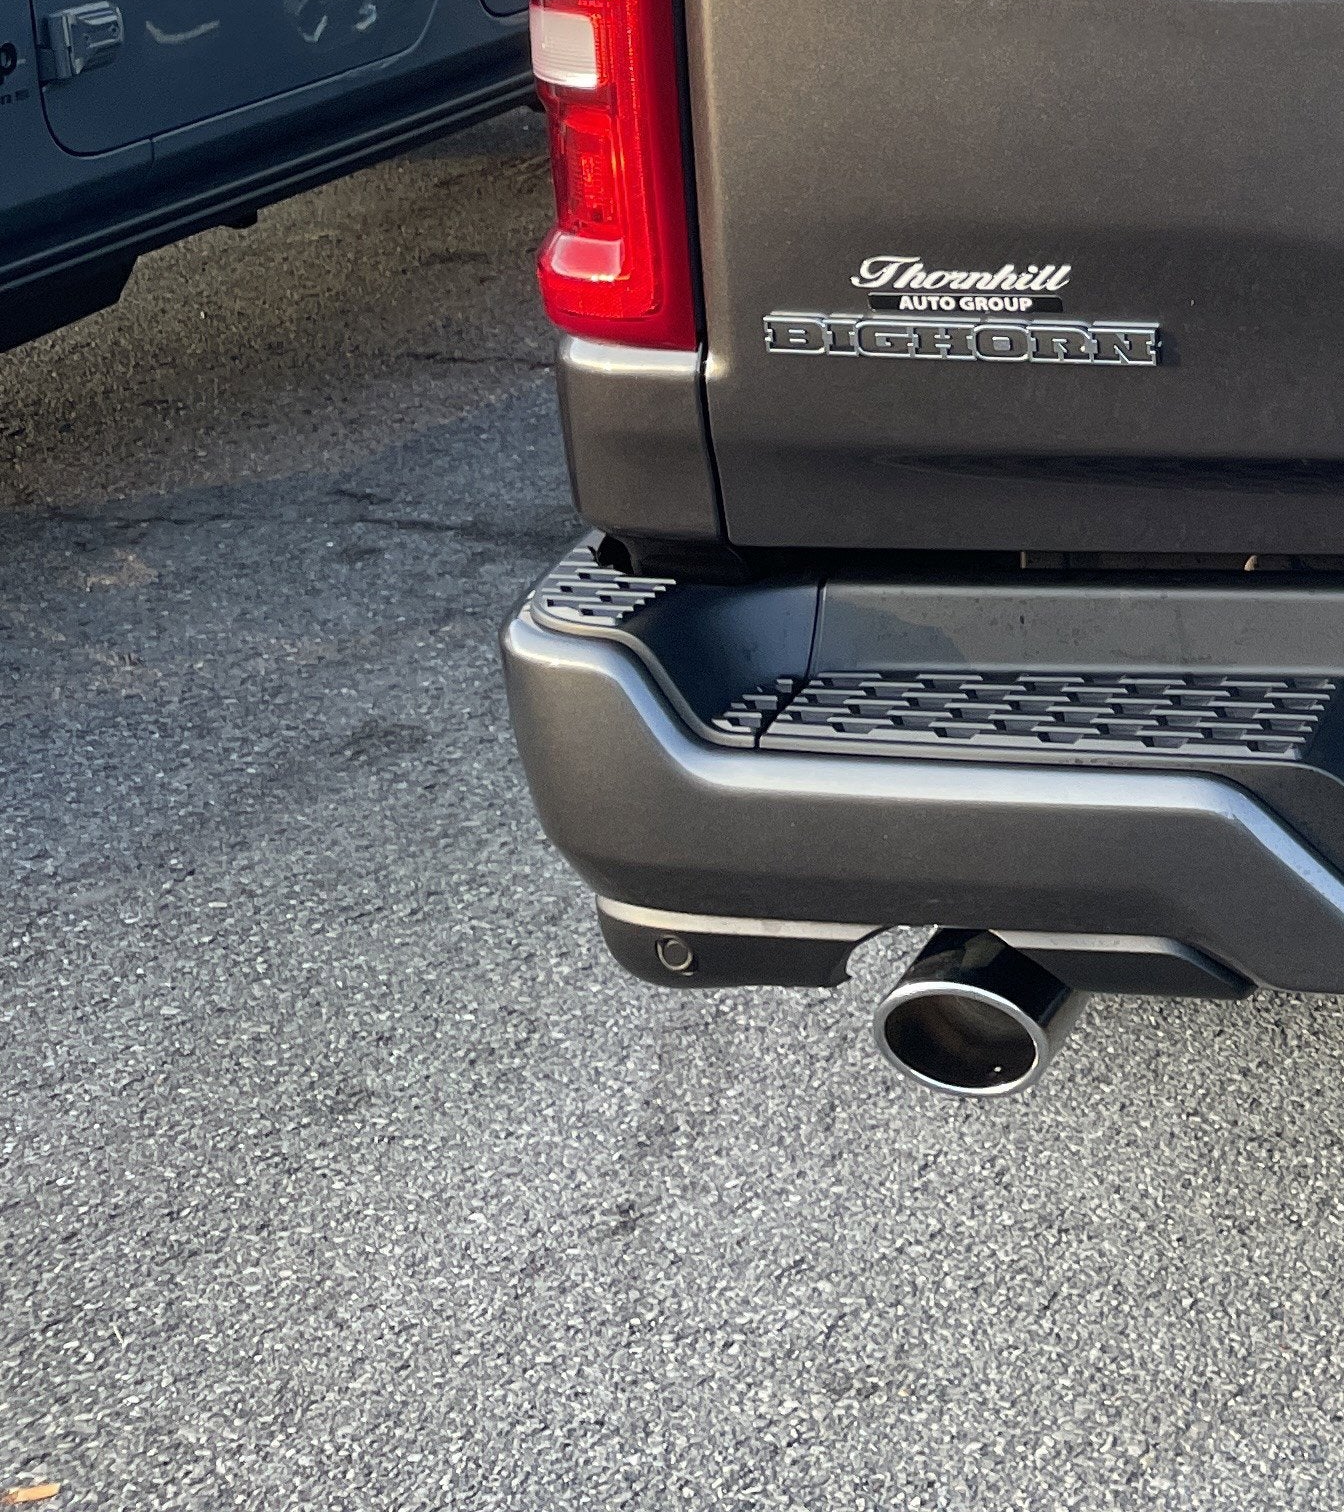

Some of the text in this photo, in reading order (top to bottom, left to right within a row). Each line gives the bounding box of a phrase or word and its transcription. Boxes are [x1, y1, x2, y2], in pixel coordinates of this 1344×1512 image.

[850, 255, 1071, 291] Thornhill
[898, 294, 1034, 313] AUTO GROUP
[763, 311, 1161, 366] BIGHORN
